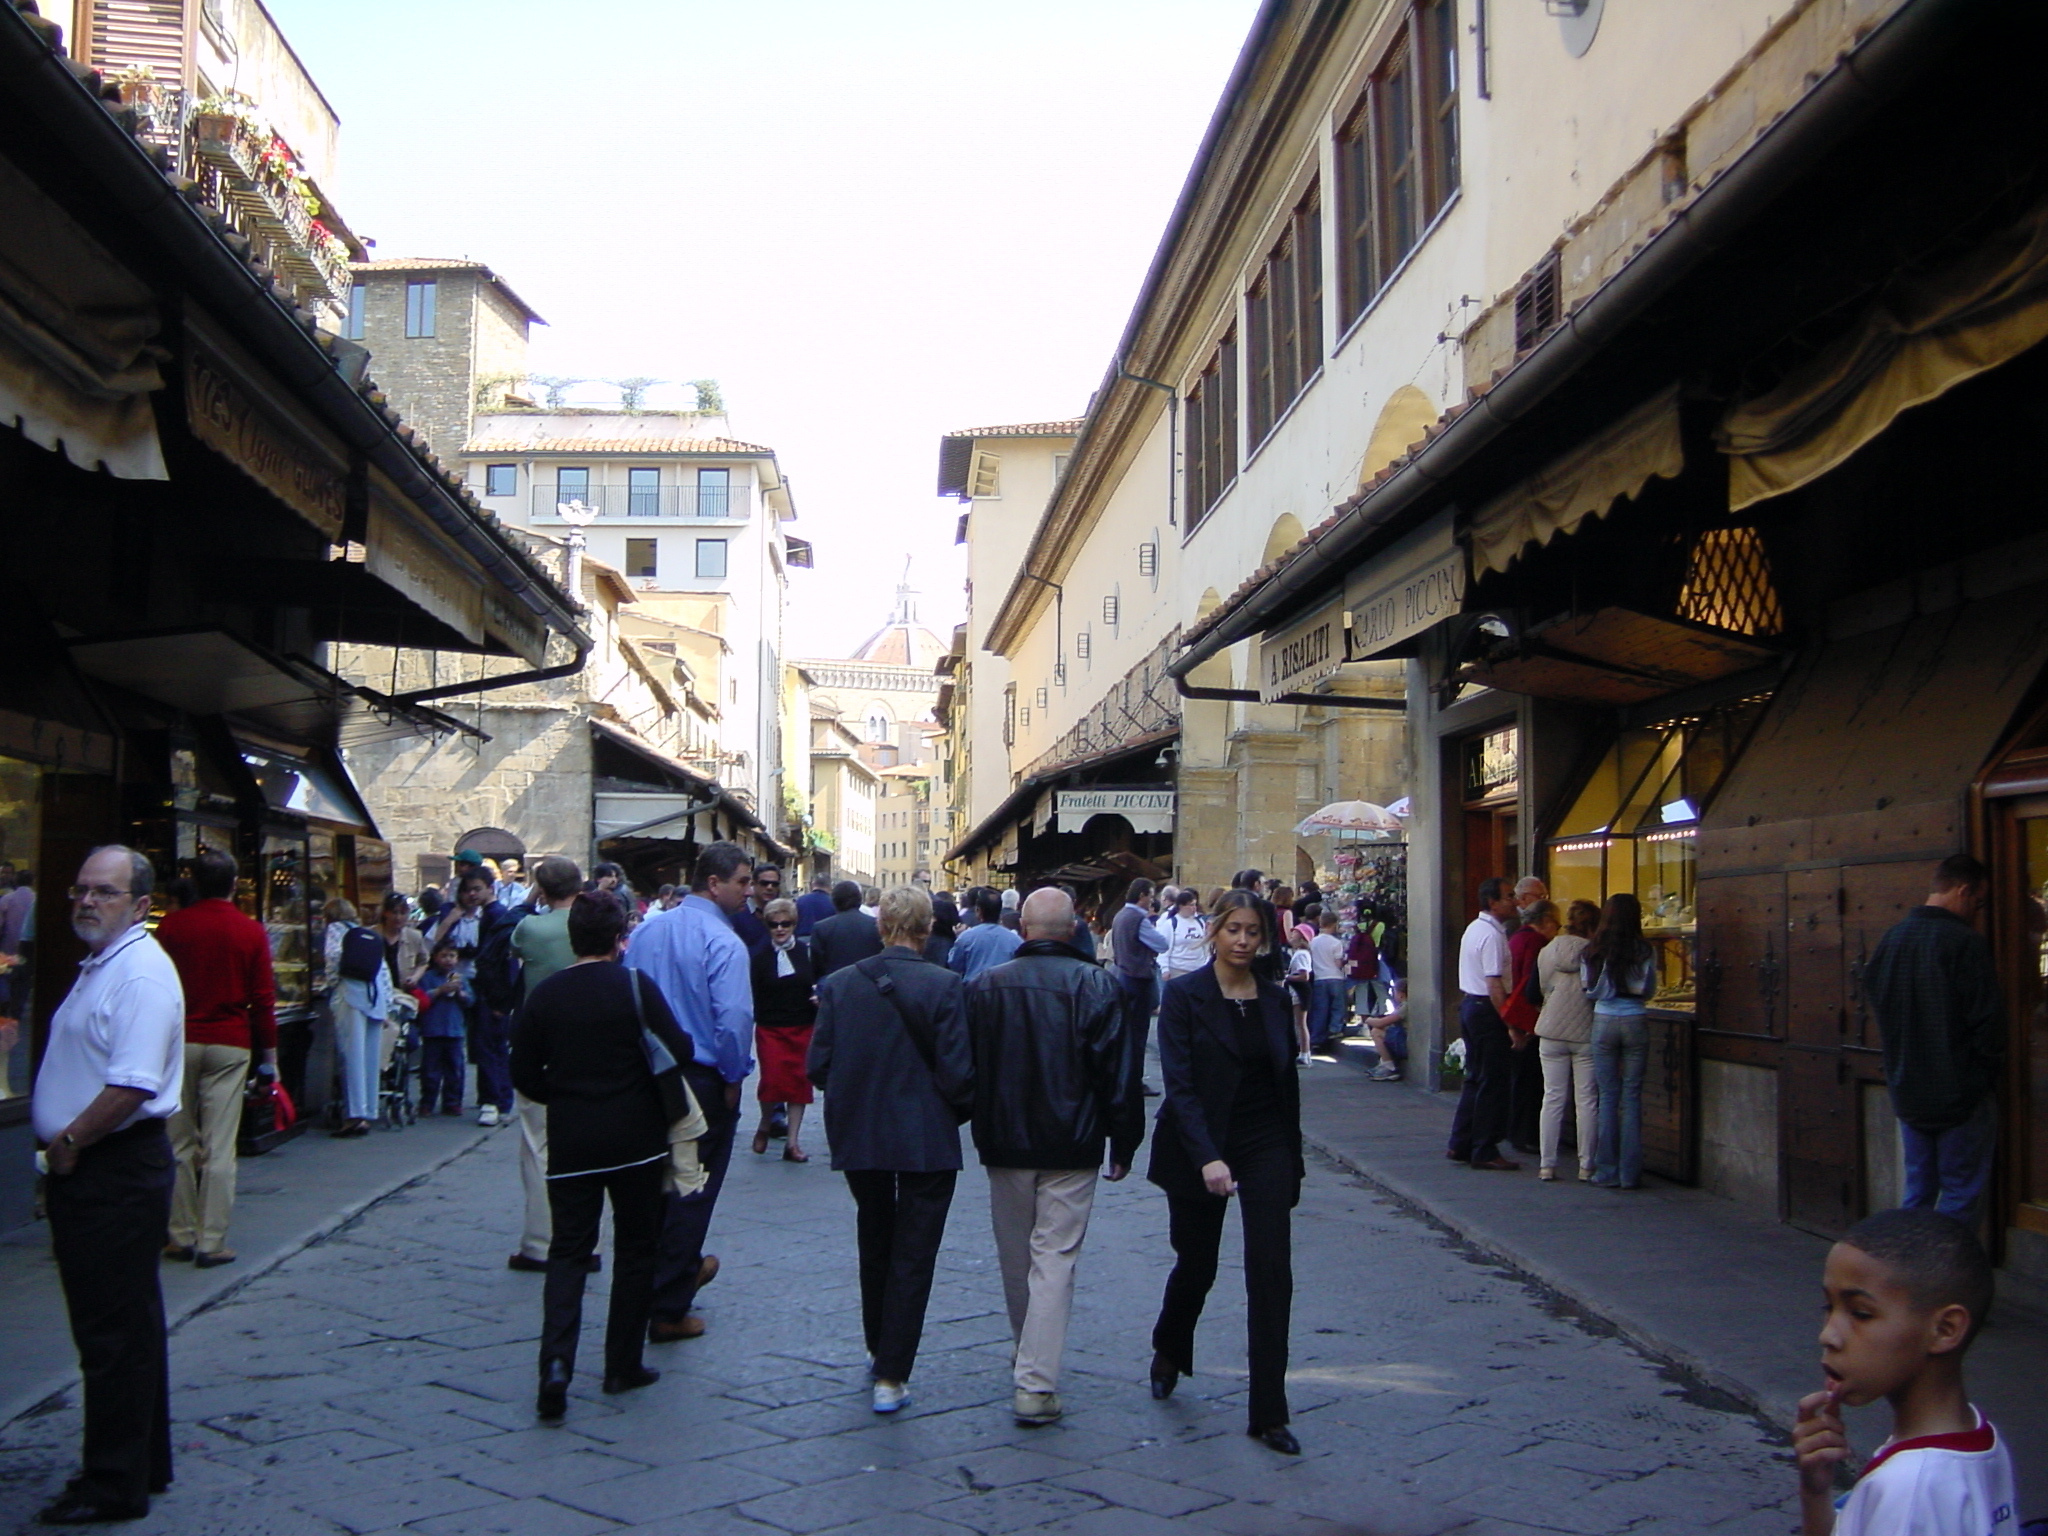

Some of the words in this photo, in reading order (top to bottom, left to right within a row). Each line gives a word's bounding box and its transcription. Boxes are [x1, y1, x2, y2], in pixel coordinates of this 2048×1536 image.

[1281, 622, 1330, 681] RISALITI
[1060, 794, 1106, 807] Fratelli
[1114, 794, 1170, 808] PICCINI
